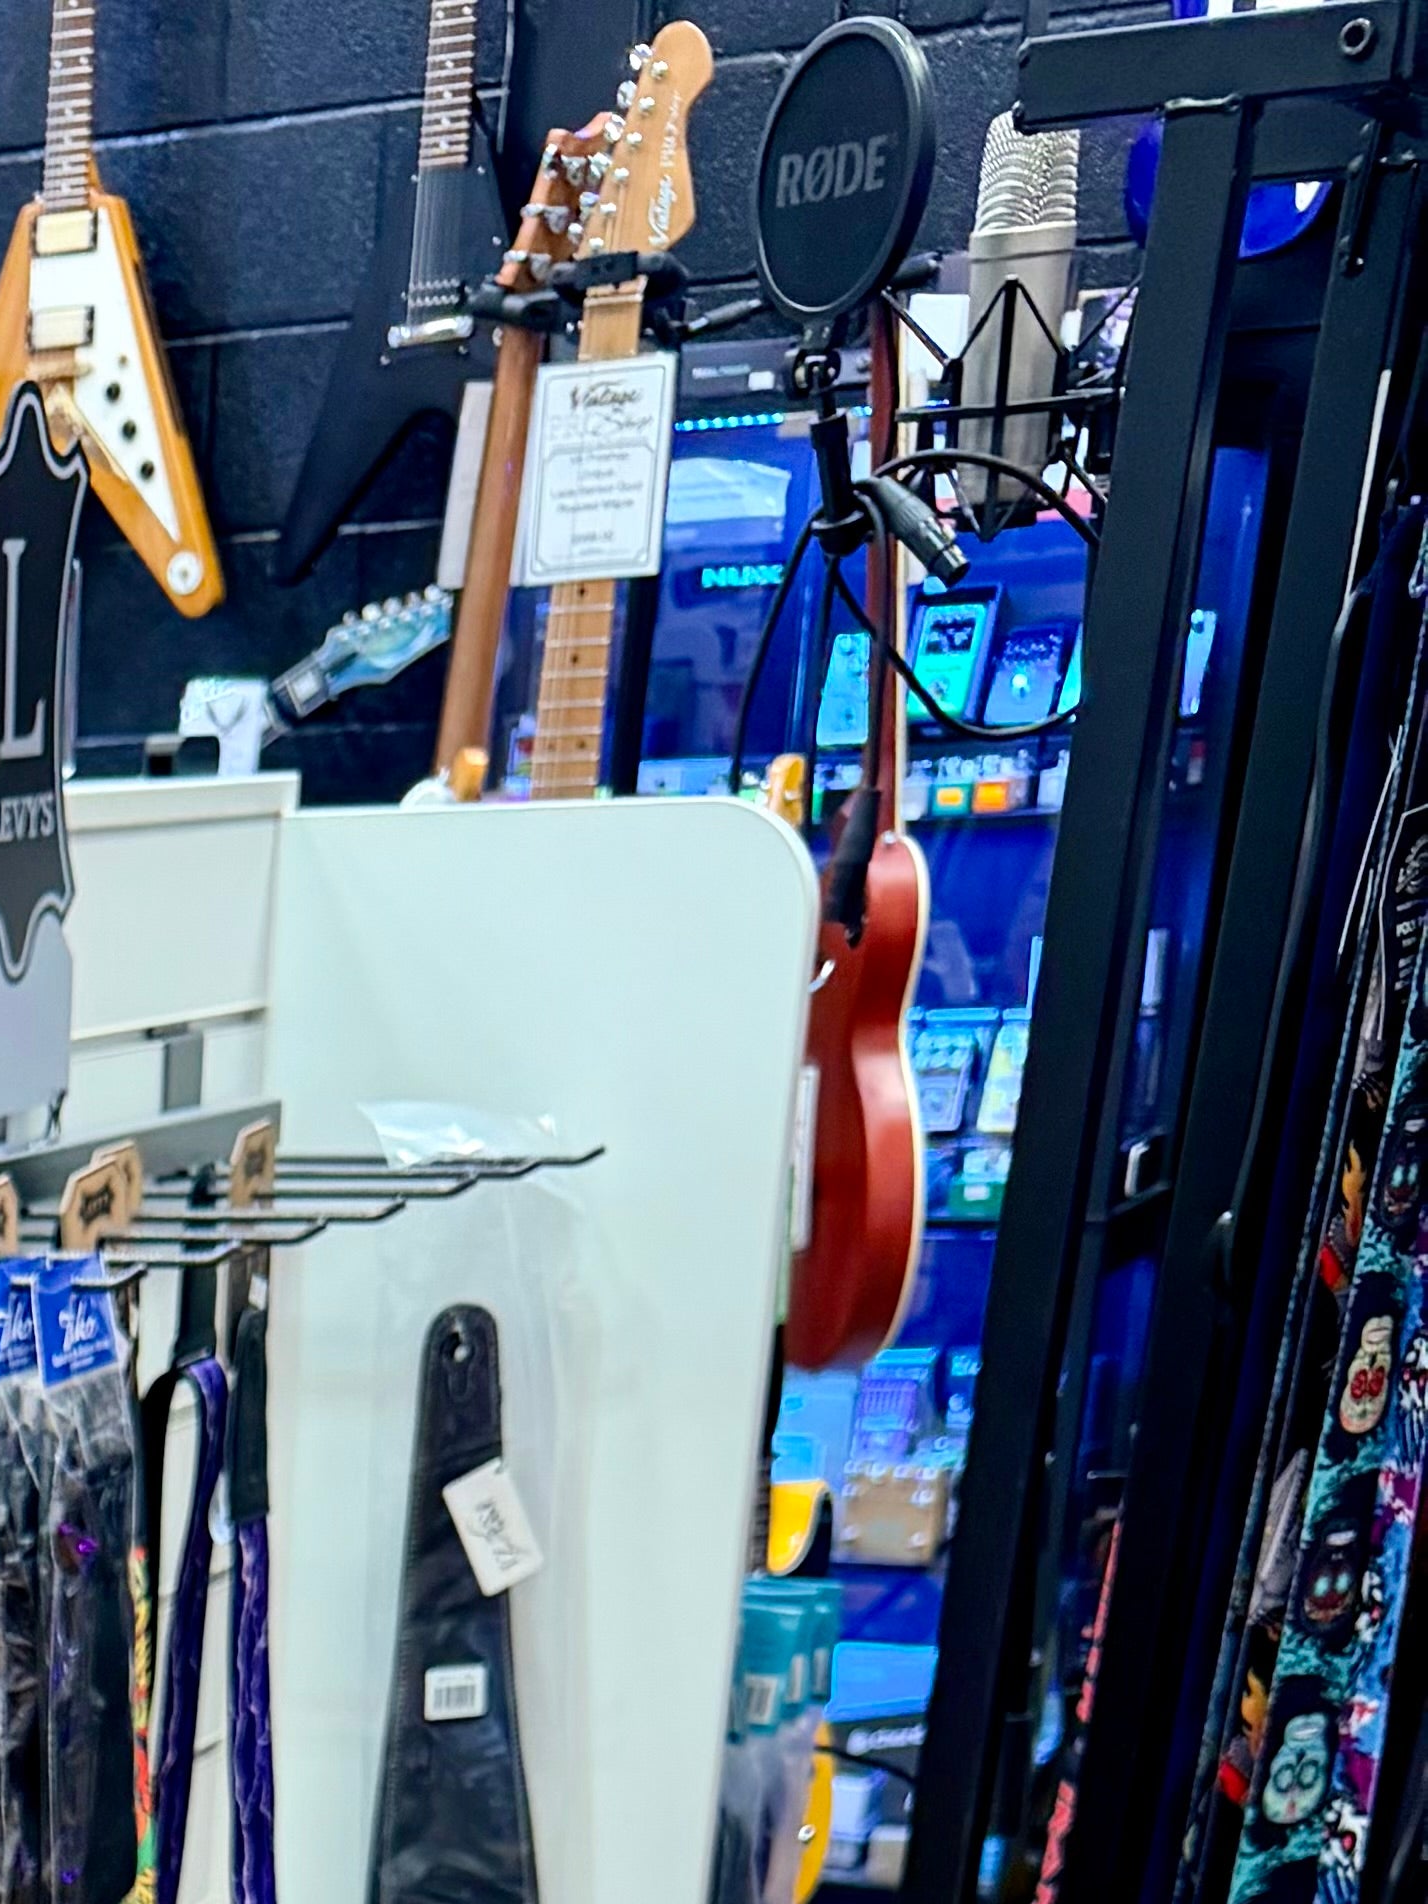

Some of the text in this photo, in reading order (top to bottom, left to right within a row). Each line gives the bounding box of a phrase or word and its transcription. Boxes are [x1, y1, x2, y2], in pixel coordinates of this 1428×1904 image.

[775, 133, 889, 209] RØDE
[648, 174, 678, 246] Vintage
[570, 380, 642, 411] Vintage
